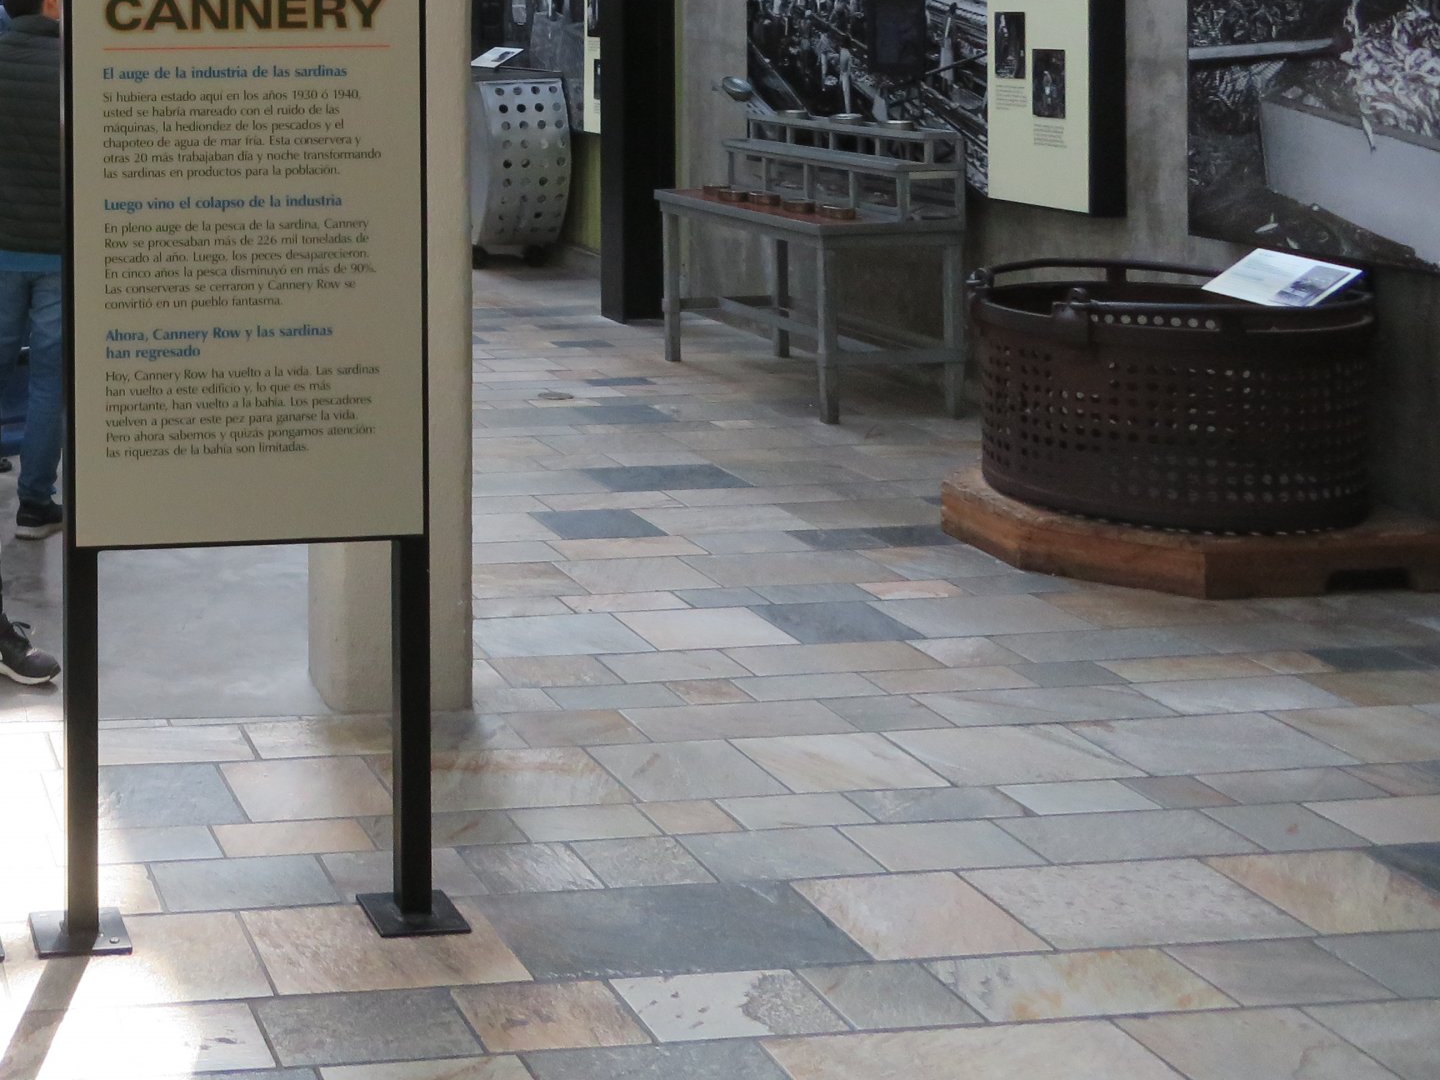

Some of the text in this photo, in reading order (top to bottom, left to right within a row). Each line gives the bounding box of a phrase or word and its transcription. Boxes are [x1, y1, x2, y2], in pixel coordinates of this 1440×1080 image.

[101, 65, 347, 82] El auge de la industria de las sardinas
[115, 92, 157, 102] hubiera
[159, 91, 197, 102] estado
[242, 90, 259, 101] los
[261, 90, 288, 101] años
[292, 90, 318, 100] 1930
[102, 107, 133, 118] usted
[135, 110, 149, 118] se
[188, 106, 237, 117] mareado
[239, 108, 260, 116] con
[262, 105, 274, 116] el
[275, 104, 306, 116] ruido
[307, 104, 322, 115] de
[324, 104, 340, 115] las
[102, 154, 130, 164] otras
[133, 153, 148, 163] 20
[176, 150, 234, 166] trabajaban
[265, 150, 300, 161] noche
[302, 148, 382, 160] transformando
[102, 168, 118, 179] las
[120, 167, 166, 178] sardinas
[168, 170, 184, 178] en
[185, 166, 242, 180] productos
[244, 169, 269, 180] para
[271, 165, 282, 176] la
[103, 194, 342, 214] Luego vino el colapso de la industria
[103, 236, 128, 248] Row
[146, 235, 211, 251] procesaban
[238, 235, 253, 246] de
[256, 235, 277, 246] 226
[280, 234, 298, 245] mil
[300, 233, 352, 245] toneladas
[354, 233, 369, 244] de
[103, 251, 150, 267] pescado
[152, 252, 162, 263] al
[231, 250, 248, 261] los
[250, 253, 282, 264] peces
[103, 284, 122, 294] Las
[124, 285, 190, 294] conserveras
[193, 285, 206, 293] se
[208, 284, 255, 292] cerraron
[266, 280, 313, 292] Cannery
[315, 279, 340, 289] Row
[343, 281, 356, 289] se
[103, 298, 153, 310] convirtió
[155, 301, 170, 309] en
[172, 300, 188, 308] un
[189, 296, 229, 311] pueblo
[104, 329, 149, 342] Ahora,
[151, 328, 208, 343] Cannery
[211, 327, 241, 338] Row
[255, 325, 275, 338] las
[278, 324, 333, 337] sardinas
[104, 345, 201, 361] han regresado
[104, 401, 169, 415] importante,
[171, 400, 192, 410] han
[195, 398, 229, 410] vuelto
[241, 397, 252, 409] la
[289, 397, 308, 407] Los
[310, 394, 372, 410] pescadores
[105, 447, 121, 458] las
[123, 446, 170, 460] riquezas
[172, 445, 187, 456] de
[189, 445, 200, 456] la
[234, 446, 256, 454] son
